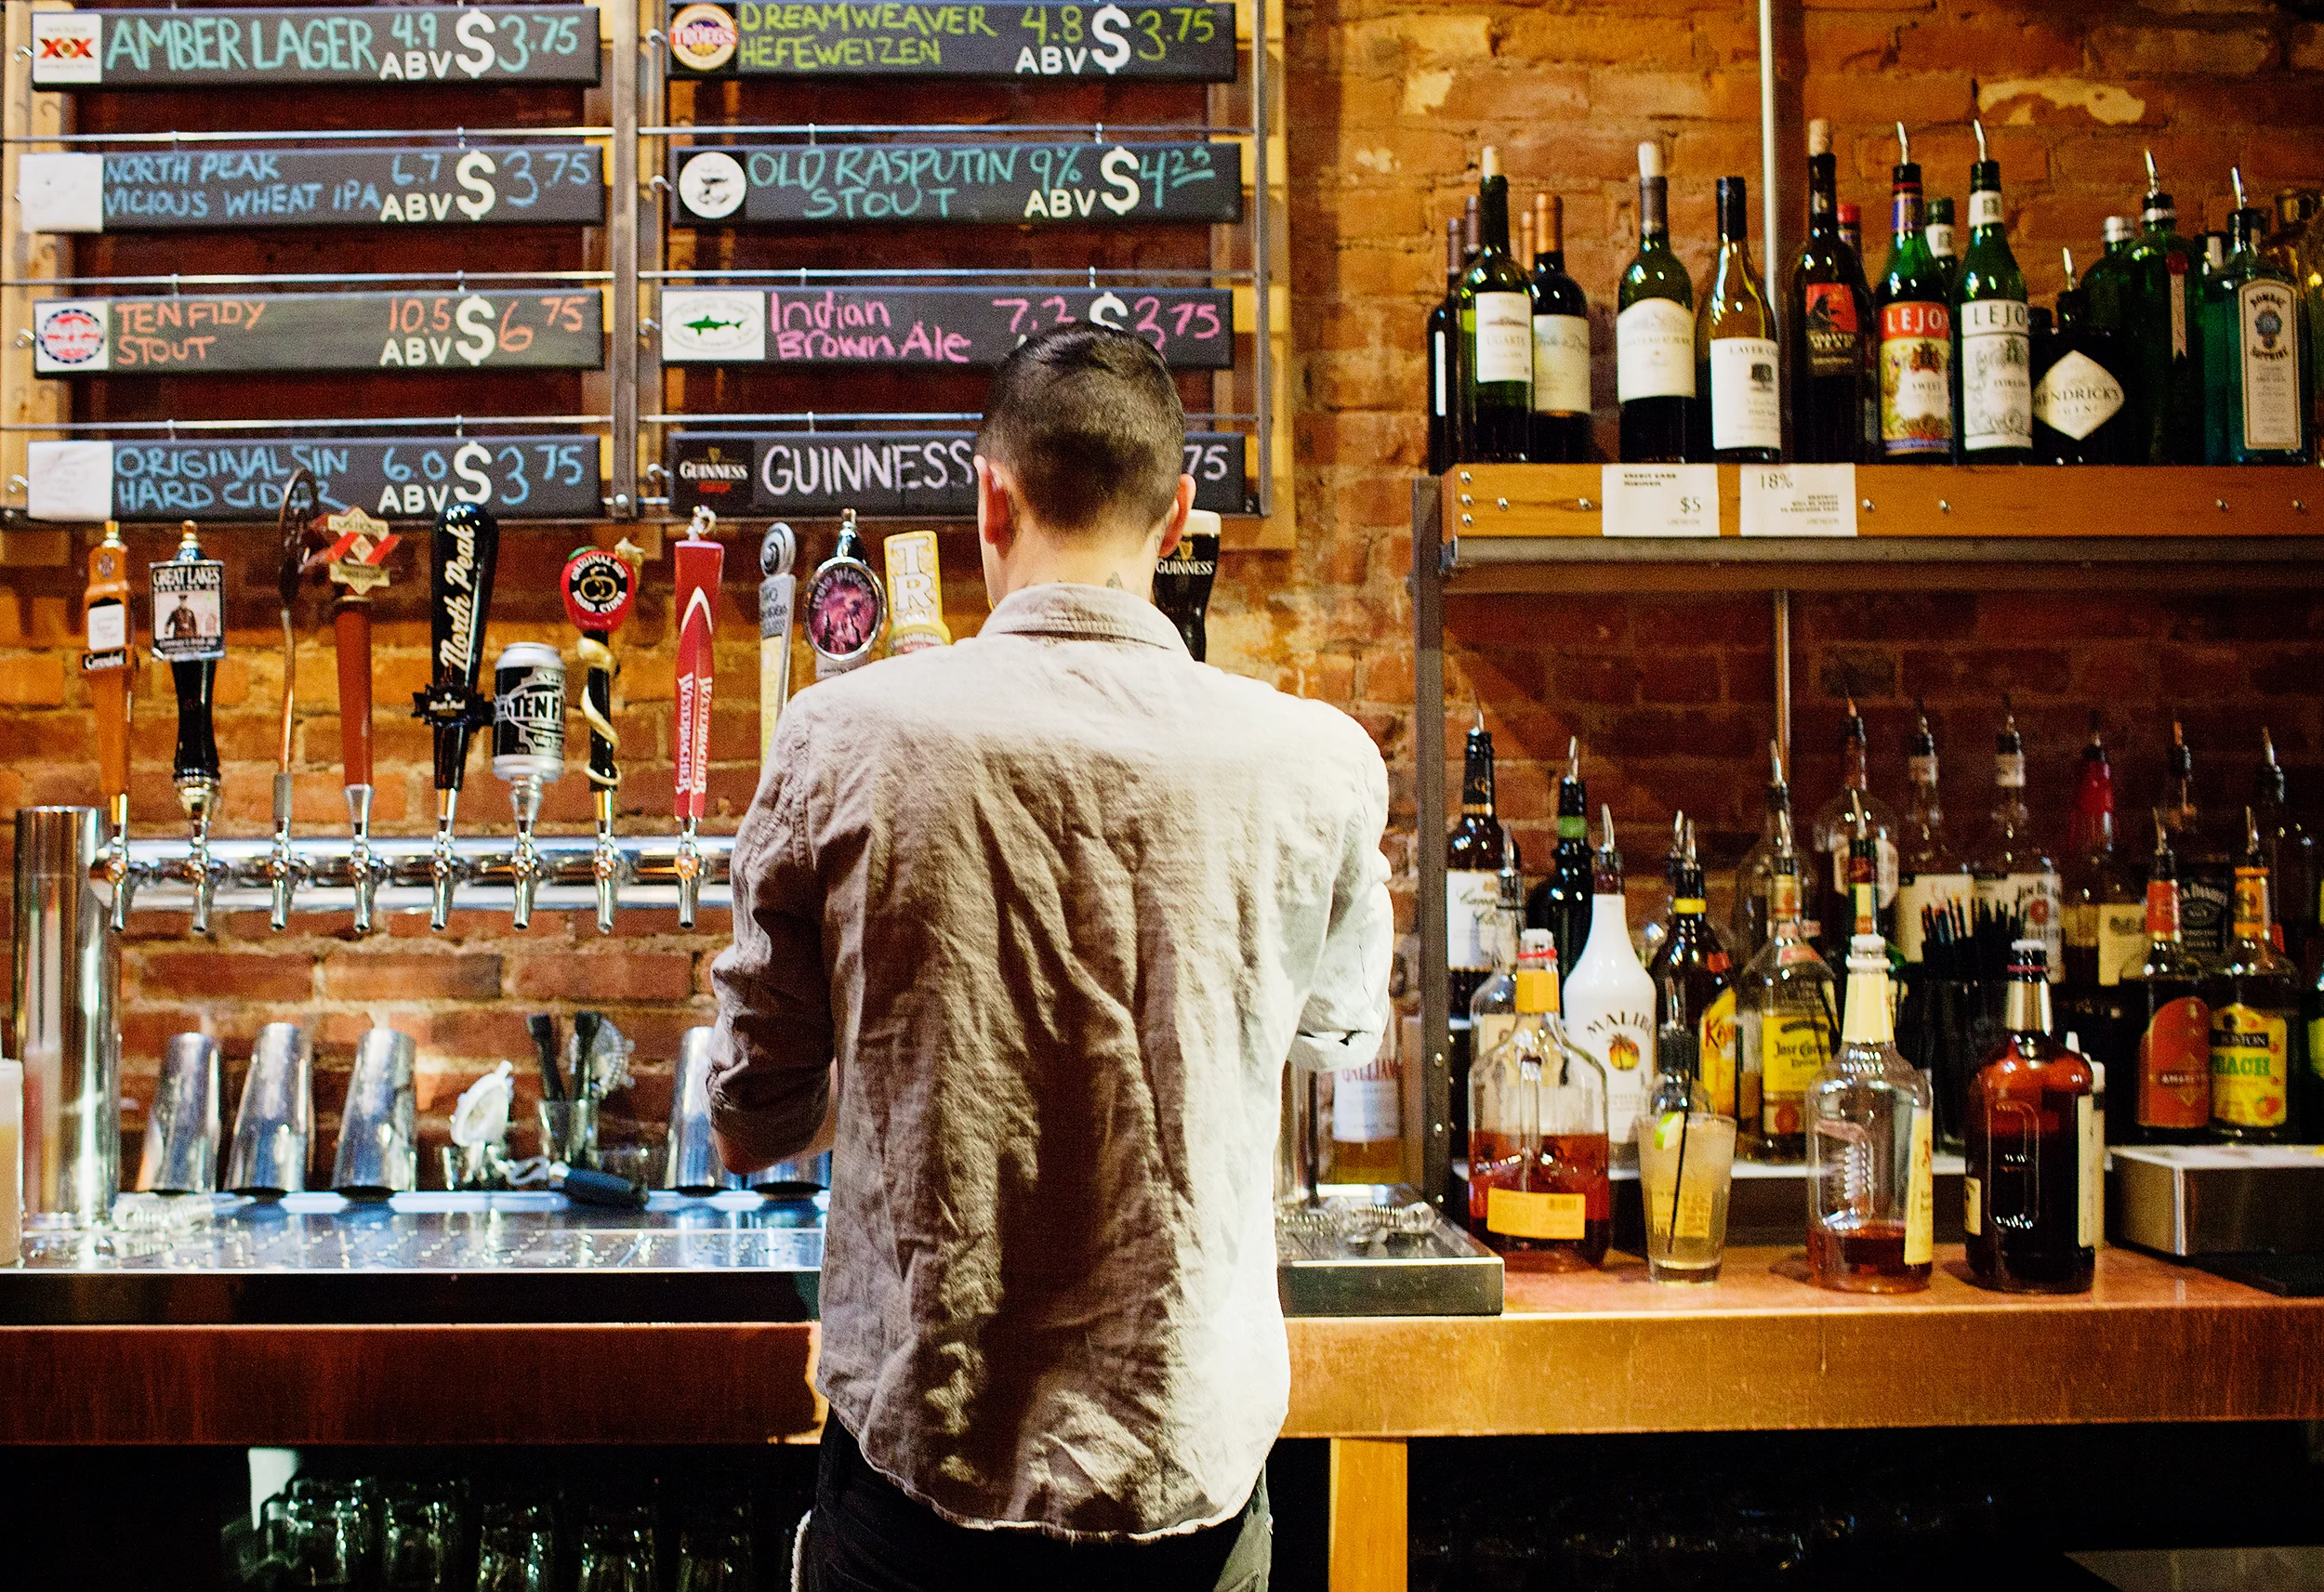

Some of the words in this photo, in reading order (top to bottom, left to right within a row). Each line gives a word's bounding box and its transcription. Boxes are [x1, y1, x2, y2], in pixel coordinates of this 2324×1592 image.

[390, 12, 438, 49] 4.9
[740, 3, 998, 37] DREAMWEAVER
[1021, 6, 1083, 46] 4.8
[105, 18, 248, 72] AMBER
[252, 18, 378, 72] LAGER
[1014, 46, 1088, 74] ABV
[379, 51, 453, 80] ABV
[103, 153, 191, 185] NORTH
[199, 151, 280, 184] PEAK
[747, 149, 825, 191] OLD
[836, 144, 1019, 188] RASPUTIN
[1030, 144, 1083, 196] 9%
[103, 189, 209, 218] VICIOUS
[224, 183, 324, 217] WHEAT
[332, 179, 383, 211] IPA
[379, 192, 453, 222] ABV
[803, 187, 957, 220] STOUT
[1024, 189, 1096, 218] ABV
[188, 300, 267, 331] FIDY
[389, 296, 452, 336] 10.5
[771, 289, 891, 335] Indian
[115, 335, 217, 365] STOUT
[379, 336, 453, 367] ABV
[777, 328, 896, 360] Brown
[899, 321, 972, 363] Ale
[290, 444, 350, 474] SIN
[382, 448, 449, 482] 6.0
[680, 460, 748, 480] GUINNESS
[761, 439, 974, 496] GUINNESS
[117, 480, 215, 511] HARD
[1761, 472, 1793, 490] 18%
[377, 484, 450, 514] ABV
[443, 523, 476, 592] Peak
[1155, 559, 1211, 576] GUINNESS
[440, 593, 471, 672] North
